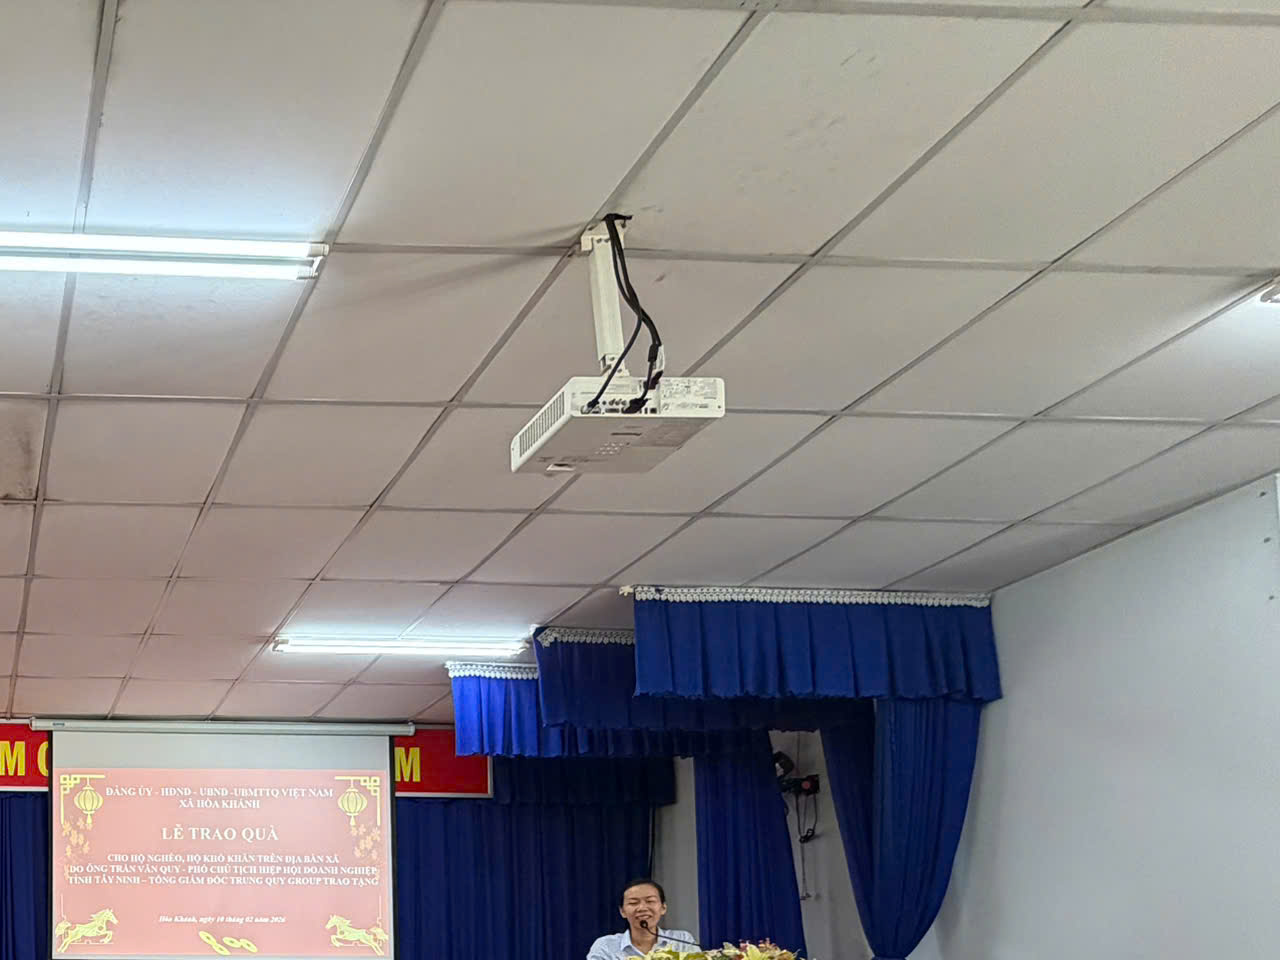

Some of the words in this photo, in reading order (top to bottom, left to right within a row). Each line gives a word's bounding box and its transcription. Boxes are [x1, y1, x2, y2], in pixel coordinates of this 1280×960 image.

[106, 785, 136, 796] ĐẢNG
[200, 787, 228, 796] UBND
[281, 787, 306, 799] VIỆT
[308, 788, 333, 797] NAM
[197, 798, 220, 808] HÒA
[222, 799, 260, 808] KHÁNH
[162, 824, 184, 840] LỄ
[188, 827, 237, 840] TRAO
[242, 825, 279, 843] QUÀ
[107, 854, 128, 862] CHO
[70, 864, 84, 872] DO
[86, 862, 108, 873] ÔNG
[304, 866, 338, 874] DOANH
[231, 876, 263, 885] TRUNG
[288, 876, 323, 886] GROUP
[323, 877, 350, 886] TRAO
